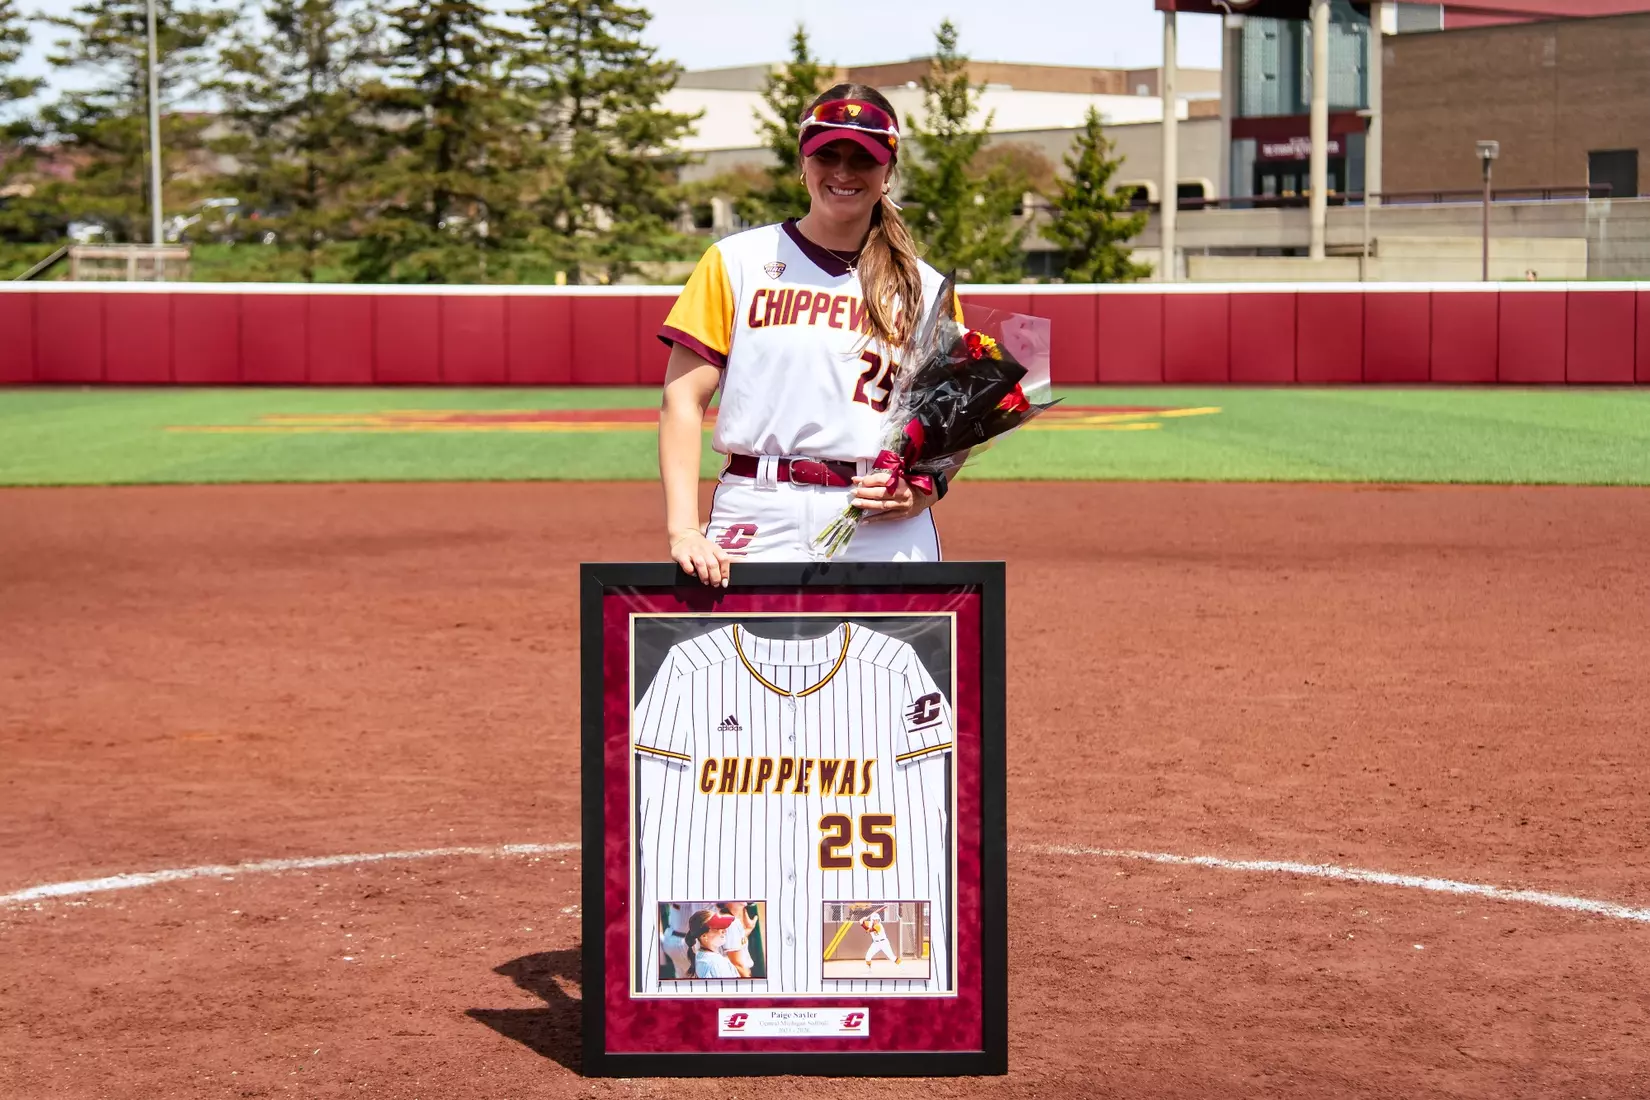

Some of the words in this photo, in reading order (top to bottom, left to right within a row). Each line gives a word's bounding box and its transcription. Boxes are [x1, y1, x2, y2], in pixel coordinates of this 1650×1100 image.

[748, 288, 905, 347] CHIPPEW
[852, 349, 900, 413] 25
[699, 756, 878, 797] CHIPPEWAS
[818, 813, 896, 871] 25
[771, 1011, 792, 1020] Paige
[793, 1011, 817, 1020] Sayler
